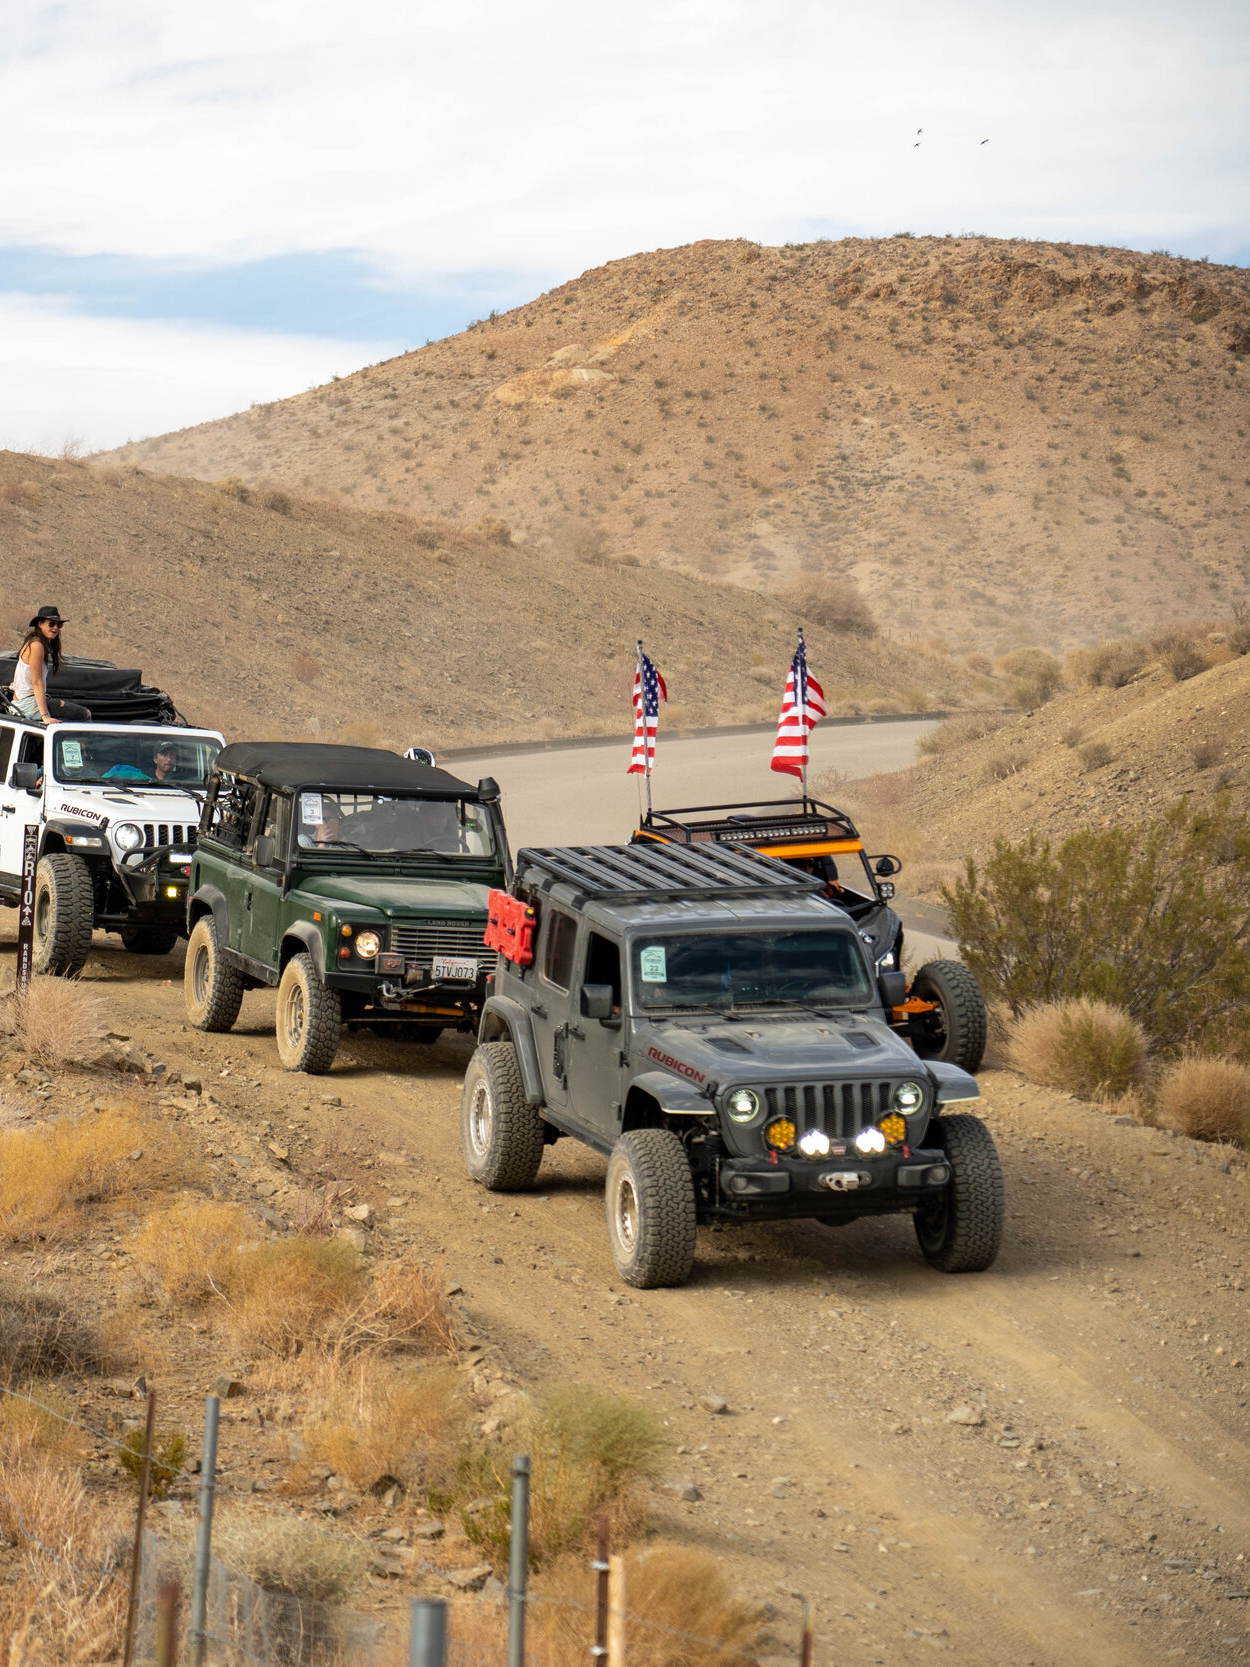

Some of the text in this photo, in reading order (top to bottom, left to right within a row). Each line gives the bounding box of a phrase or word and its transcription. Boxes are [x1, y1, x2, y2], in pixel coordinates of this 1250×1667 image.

[60, 803, 102, 821] RUBICON
[23, 861, 36, 905] R10
[21, 943, 29, 994] RANDSBU
[435, 965, 475, 979] 5TVJ073
[647, 1046, 706, 1084] RUBICON
